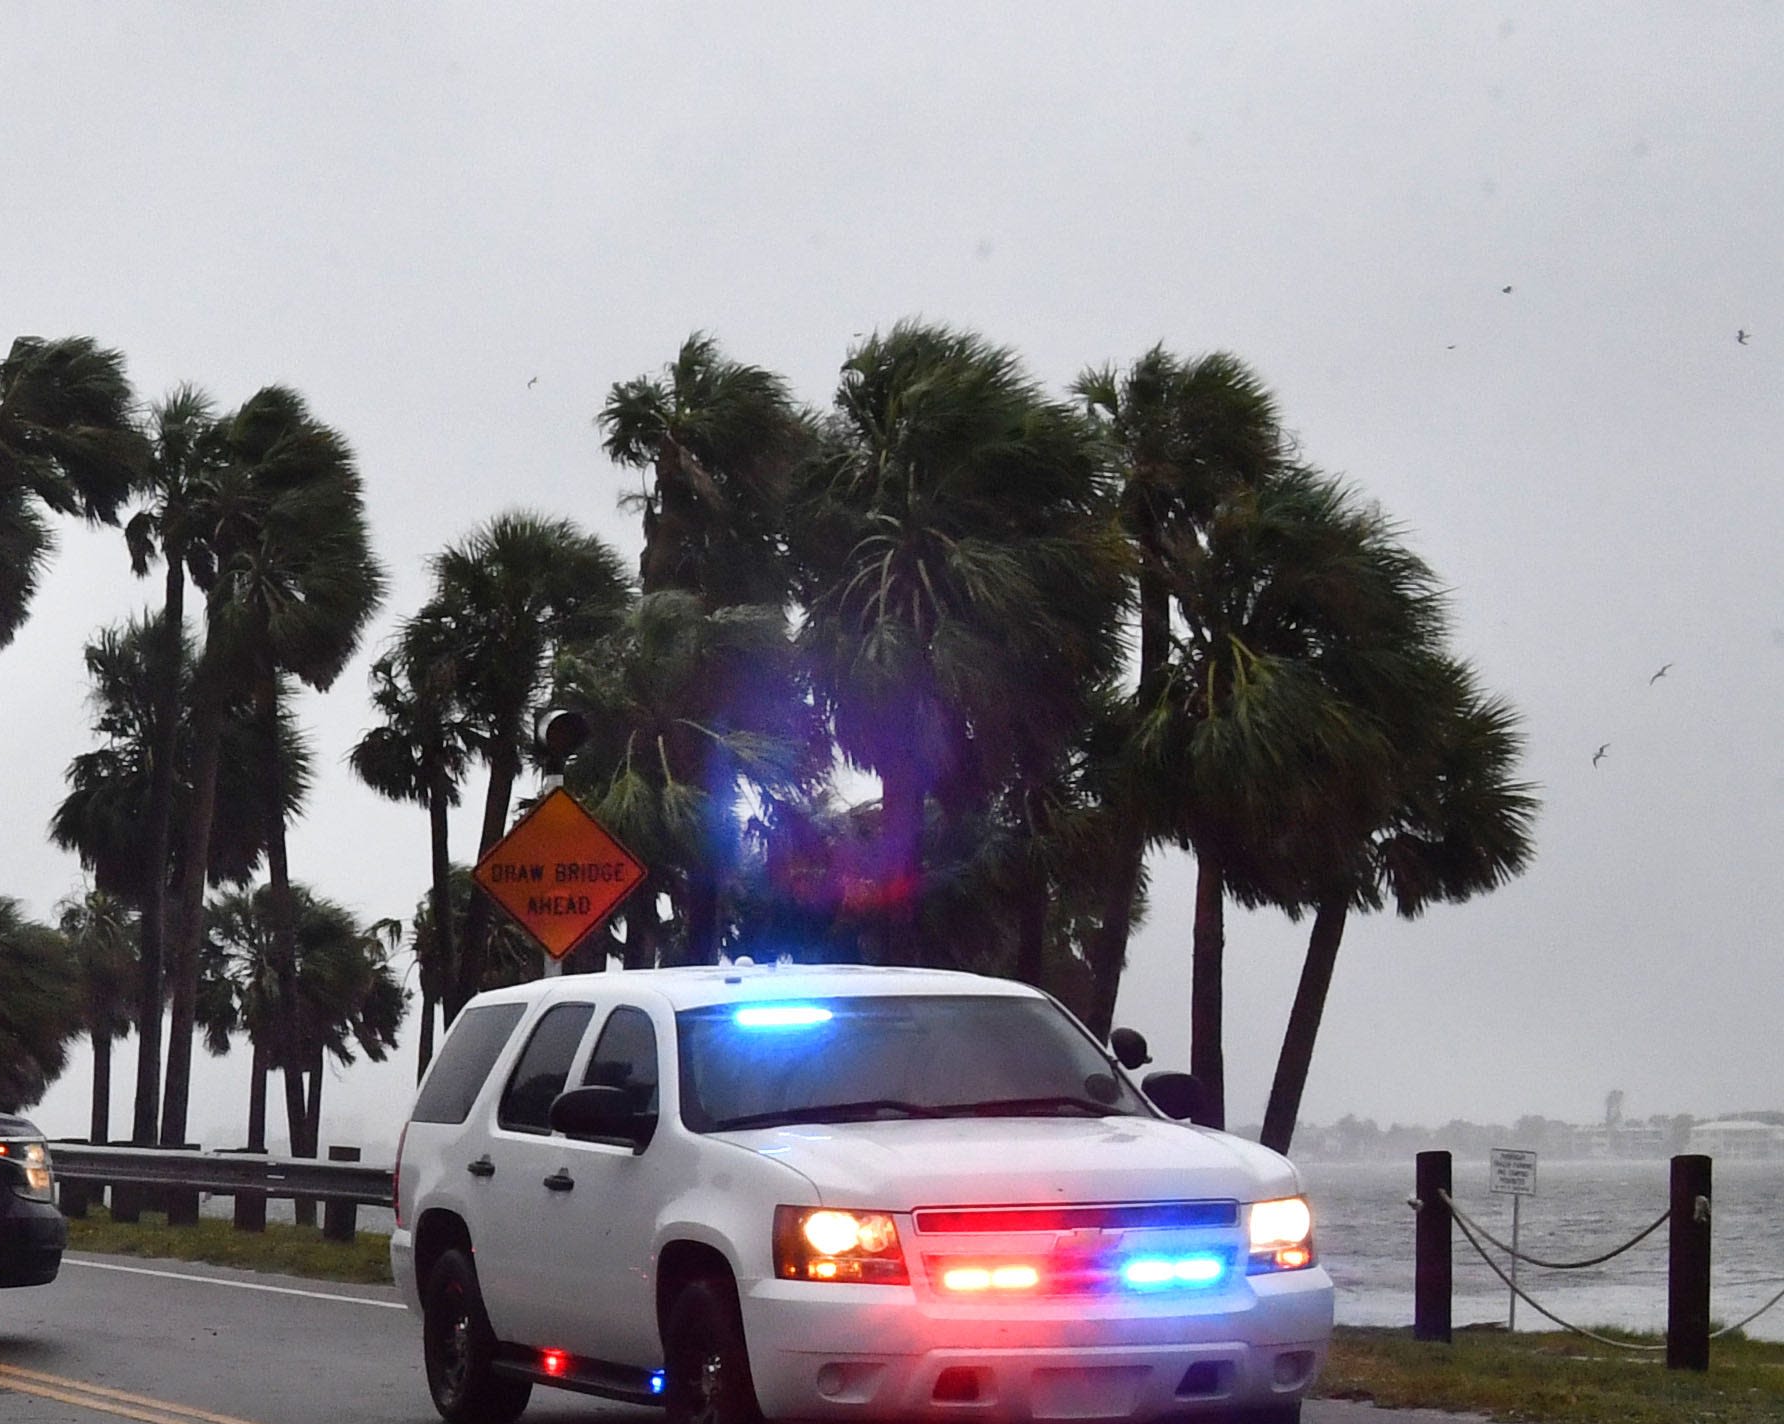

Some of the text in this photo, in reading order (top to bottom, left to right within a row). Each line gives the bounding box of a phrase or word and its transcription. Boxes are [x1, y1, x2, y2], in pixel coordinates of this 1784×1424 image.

[492, 863, 625, 882] DRAW BRIDGE
[528, 896, 592, 915] AHEAD
